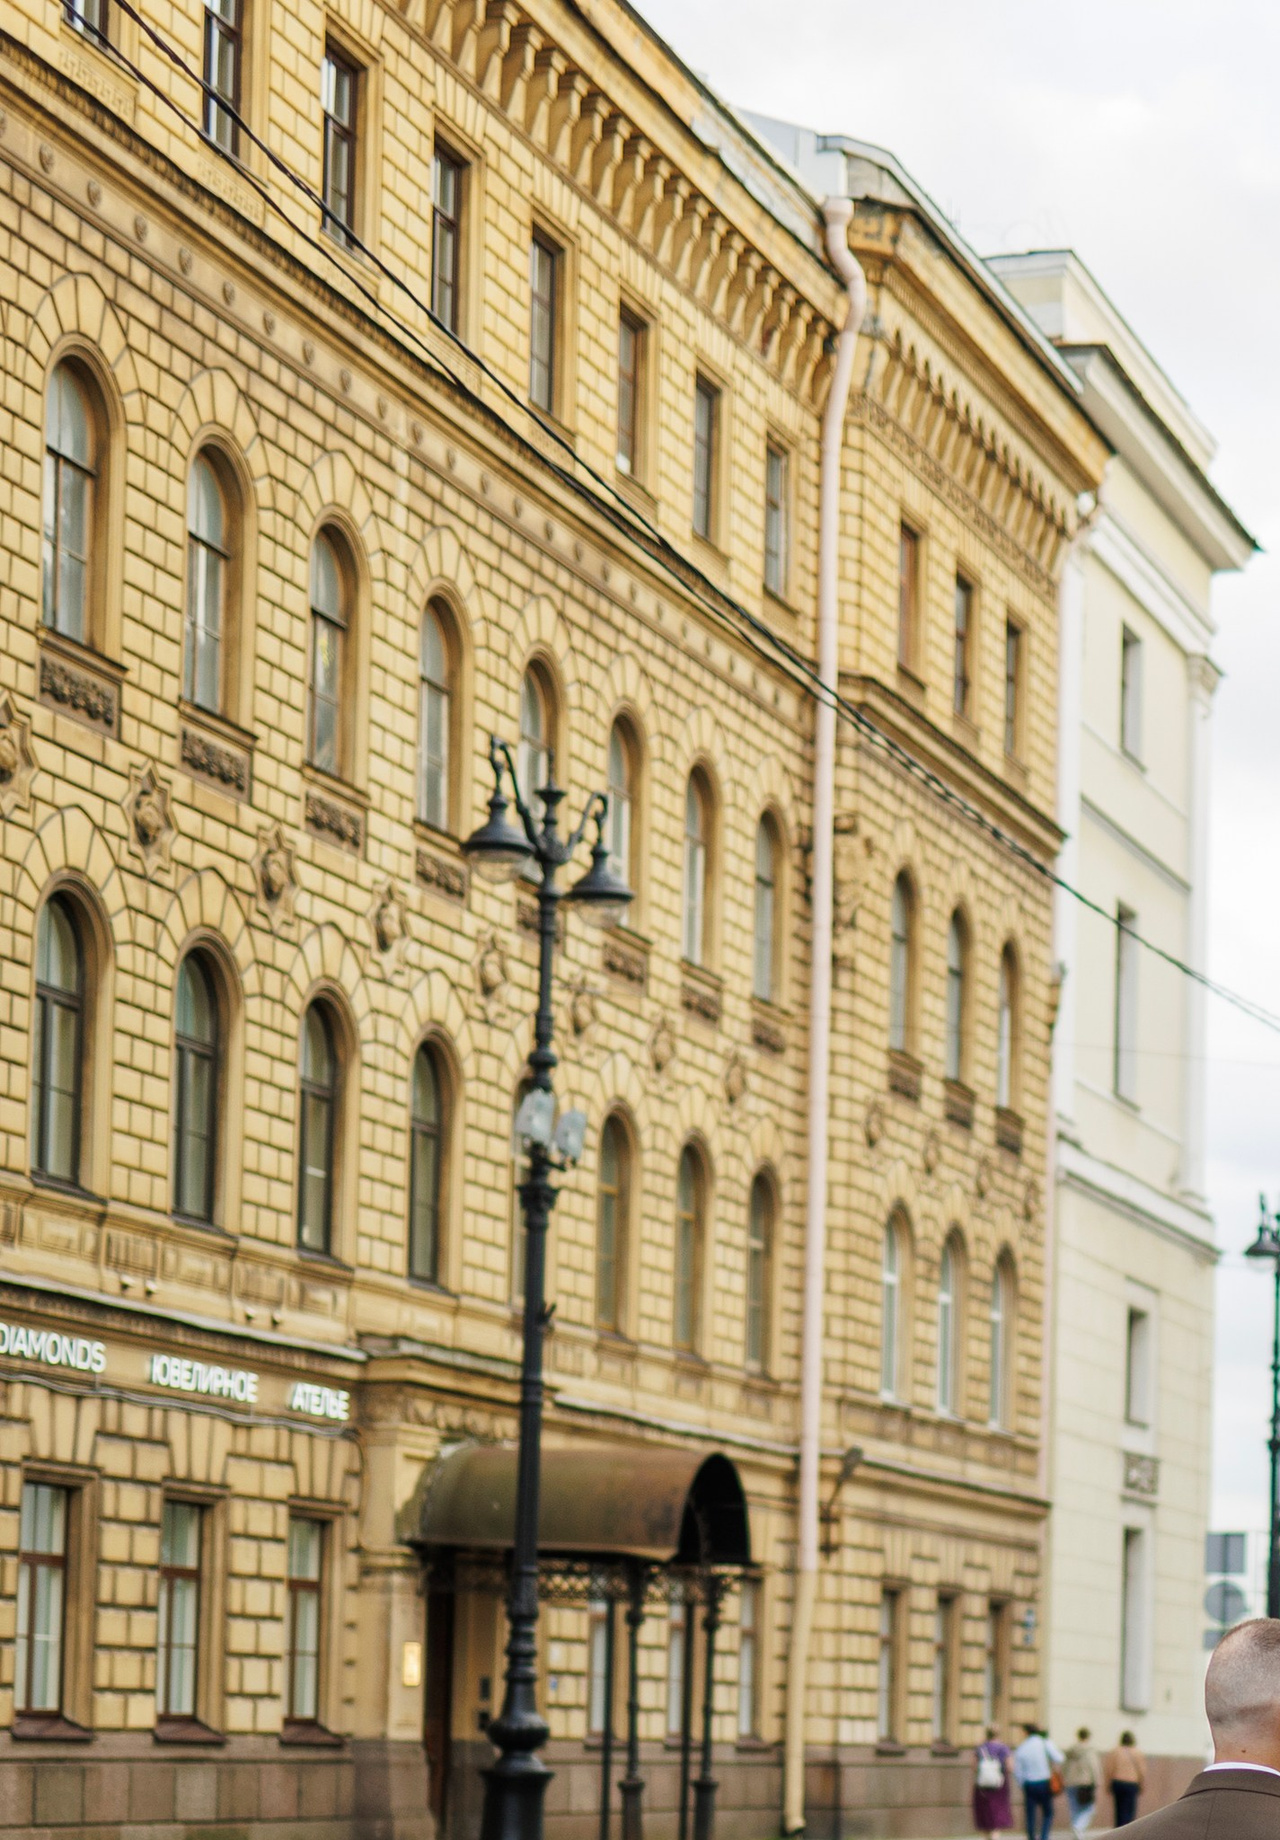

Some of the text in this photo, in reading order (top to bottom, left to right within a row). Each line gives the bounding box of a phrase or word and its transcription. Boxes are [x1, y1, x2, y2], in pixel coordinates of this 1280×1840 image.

[0, 1322, 106, 1373] DIAMONDS
[151, 1354, 350, 1420] ЮВЕЛИРНОЕ АТЕЛЬЕ
